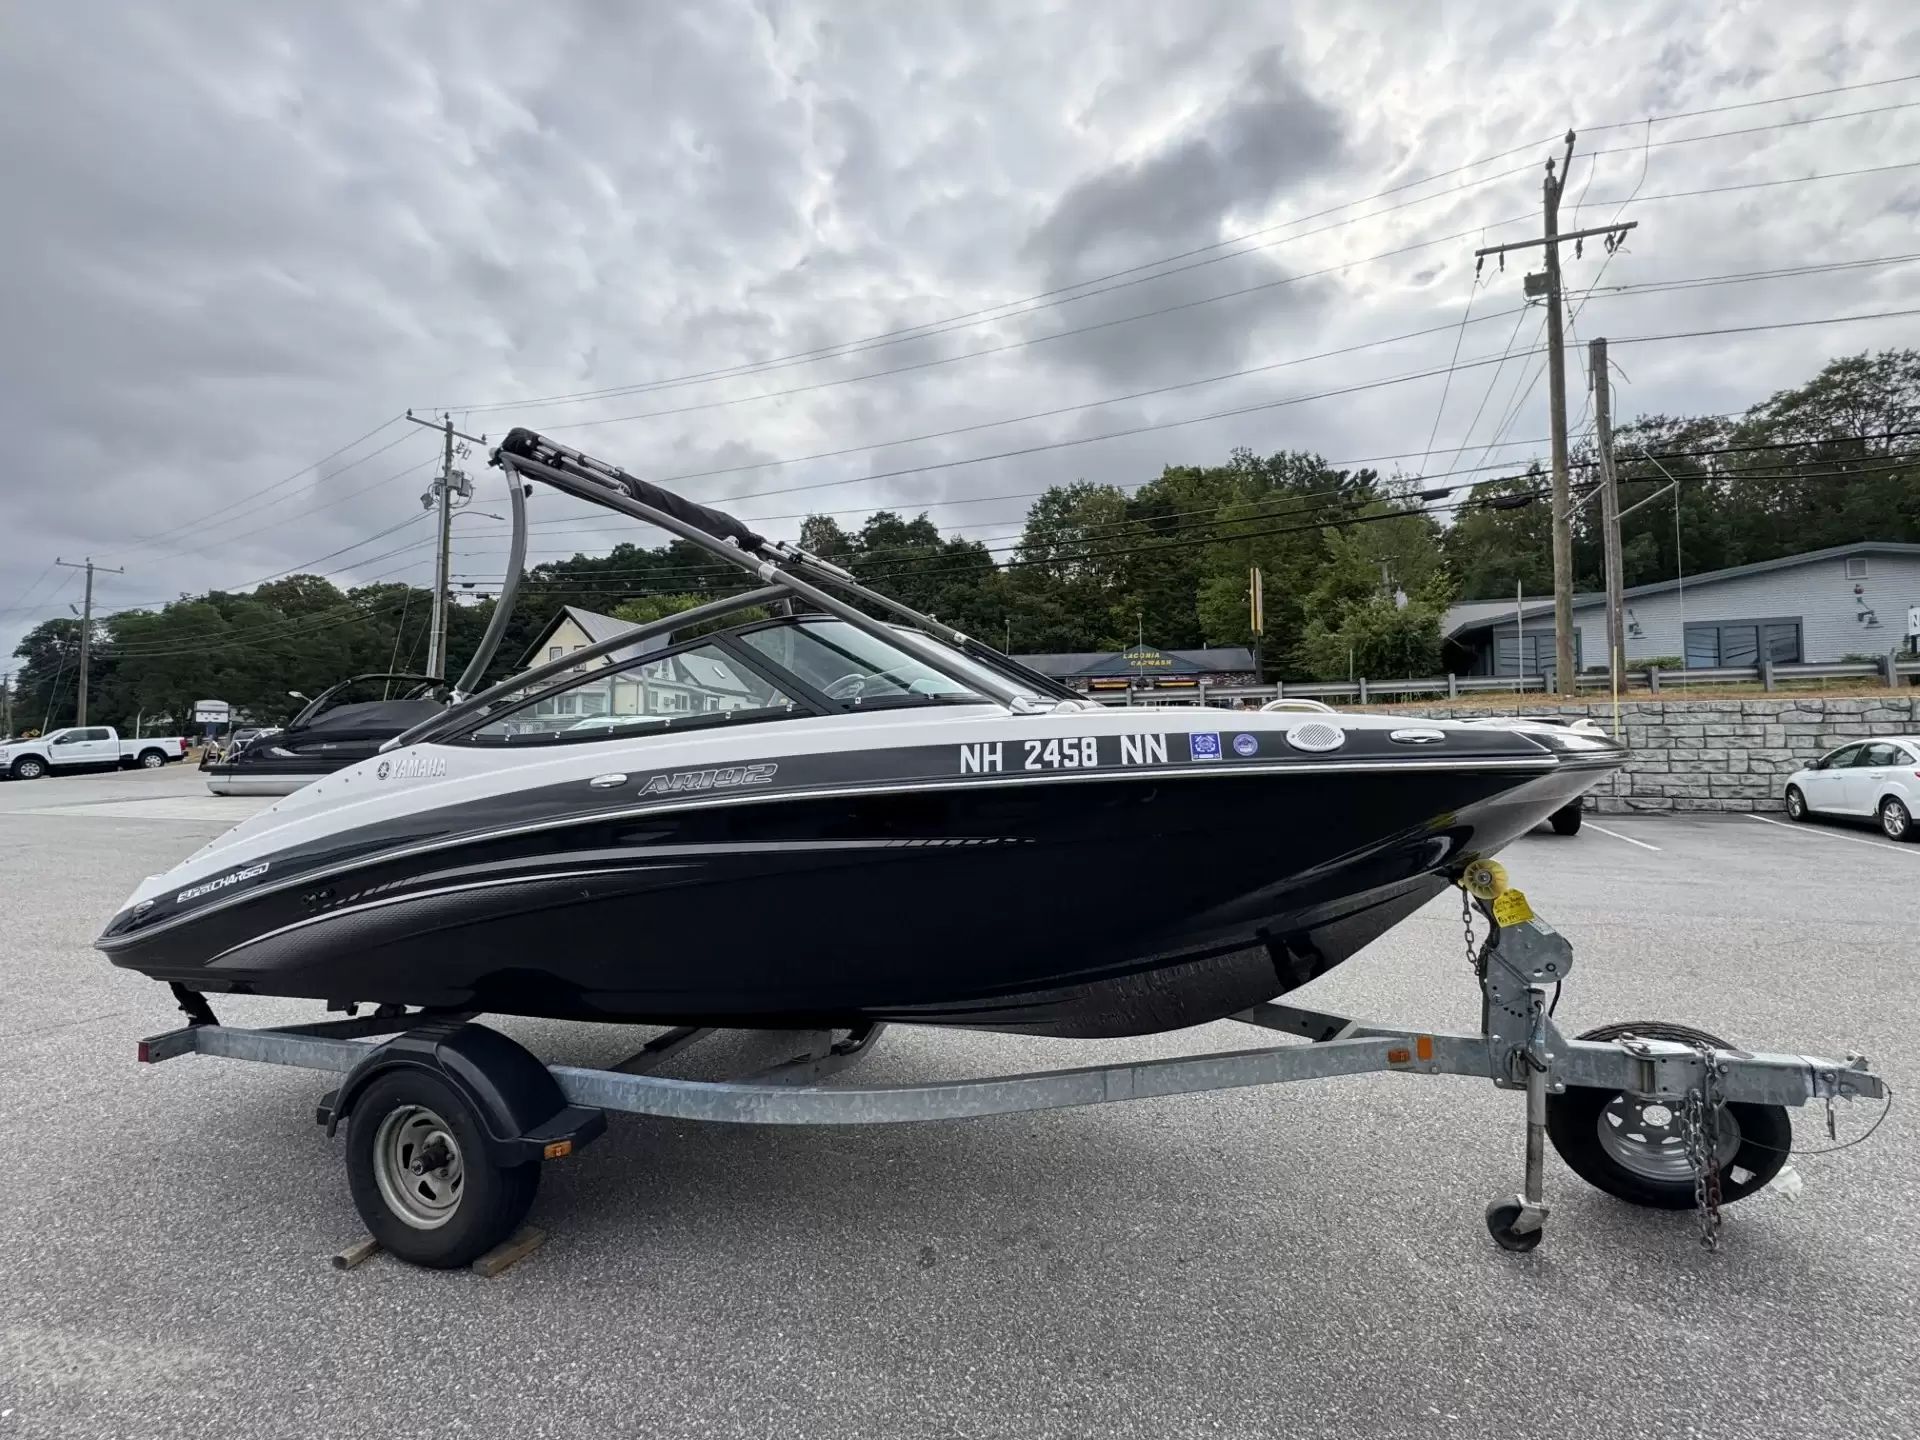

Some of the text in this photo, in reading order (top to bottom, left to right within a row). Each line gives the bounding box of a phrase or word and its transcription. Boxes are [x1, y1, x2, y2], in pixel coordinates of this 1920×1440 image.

[393, 758, 447, 778] YAMAHA
[960, 733, 1168, 774] NH 2458 NN
[638, 763, 778, 796] AR192
